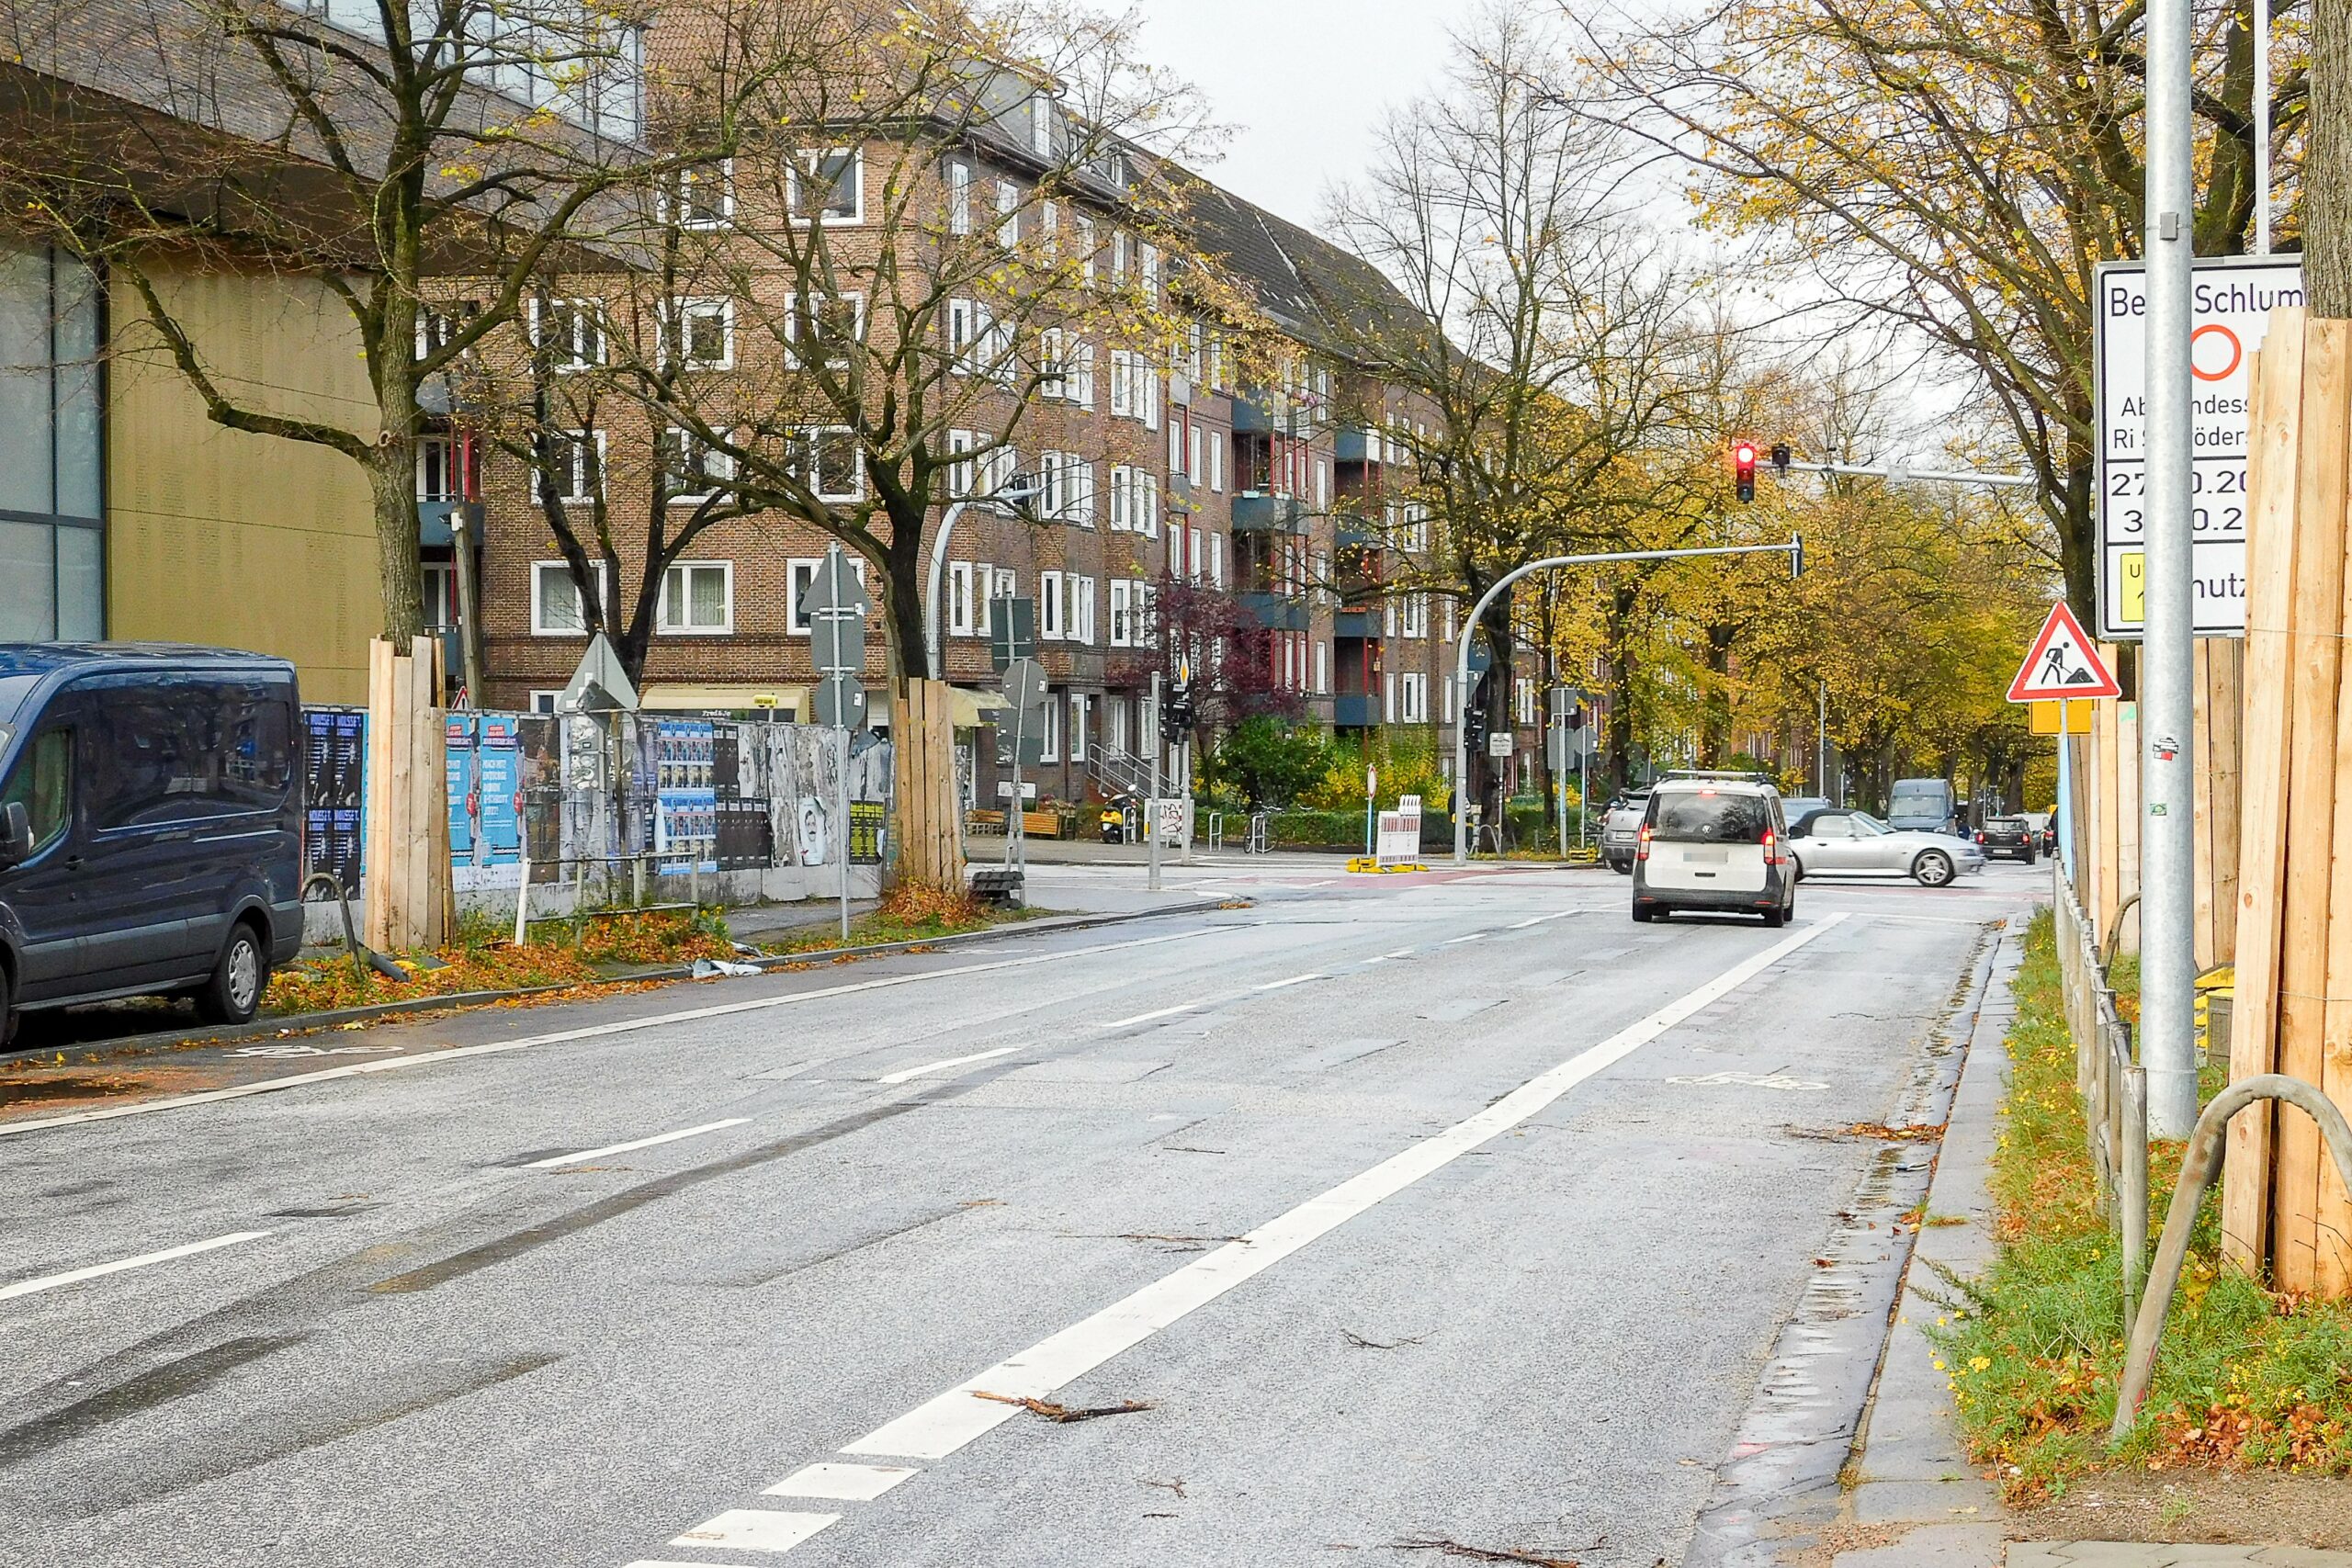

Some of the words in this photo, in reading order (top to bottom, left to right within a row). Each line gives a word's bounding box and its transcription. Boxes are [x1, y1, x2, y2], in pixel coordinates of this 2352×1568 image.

[2111, 287, 2146, 317] Be
[2194, 283, 2304, 314] Schlum
[2114, 428, 2133, 448] Ri
